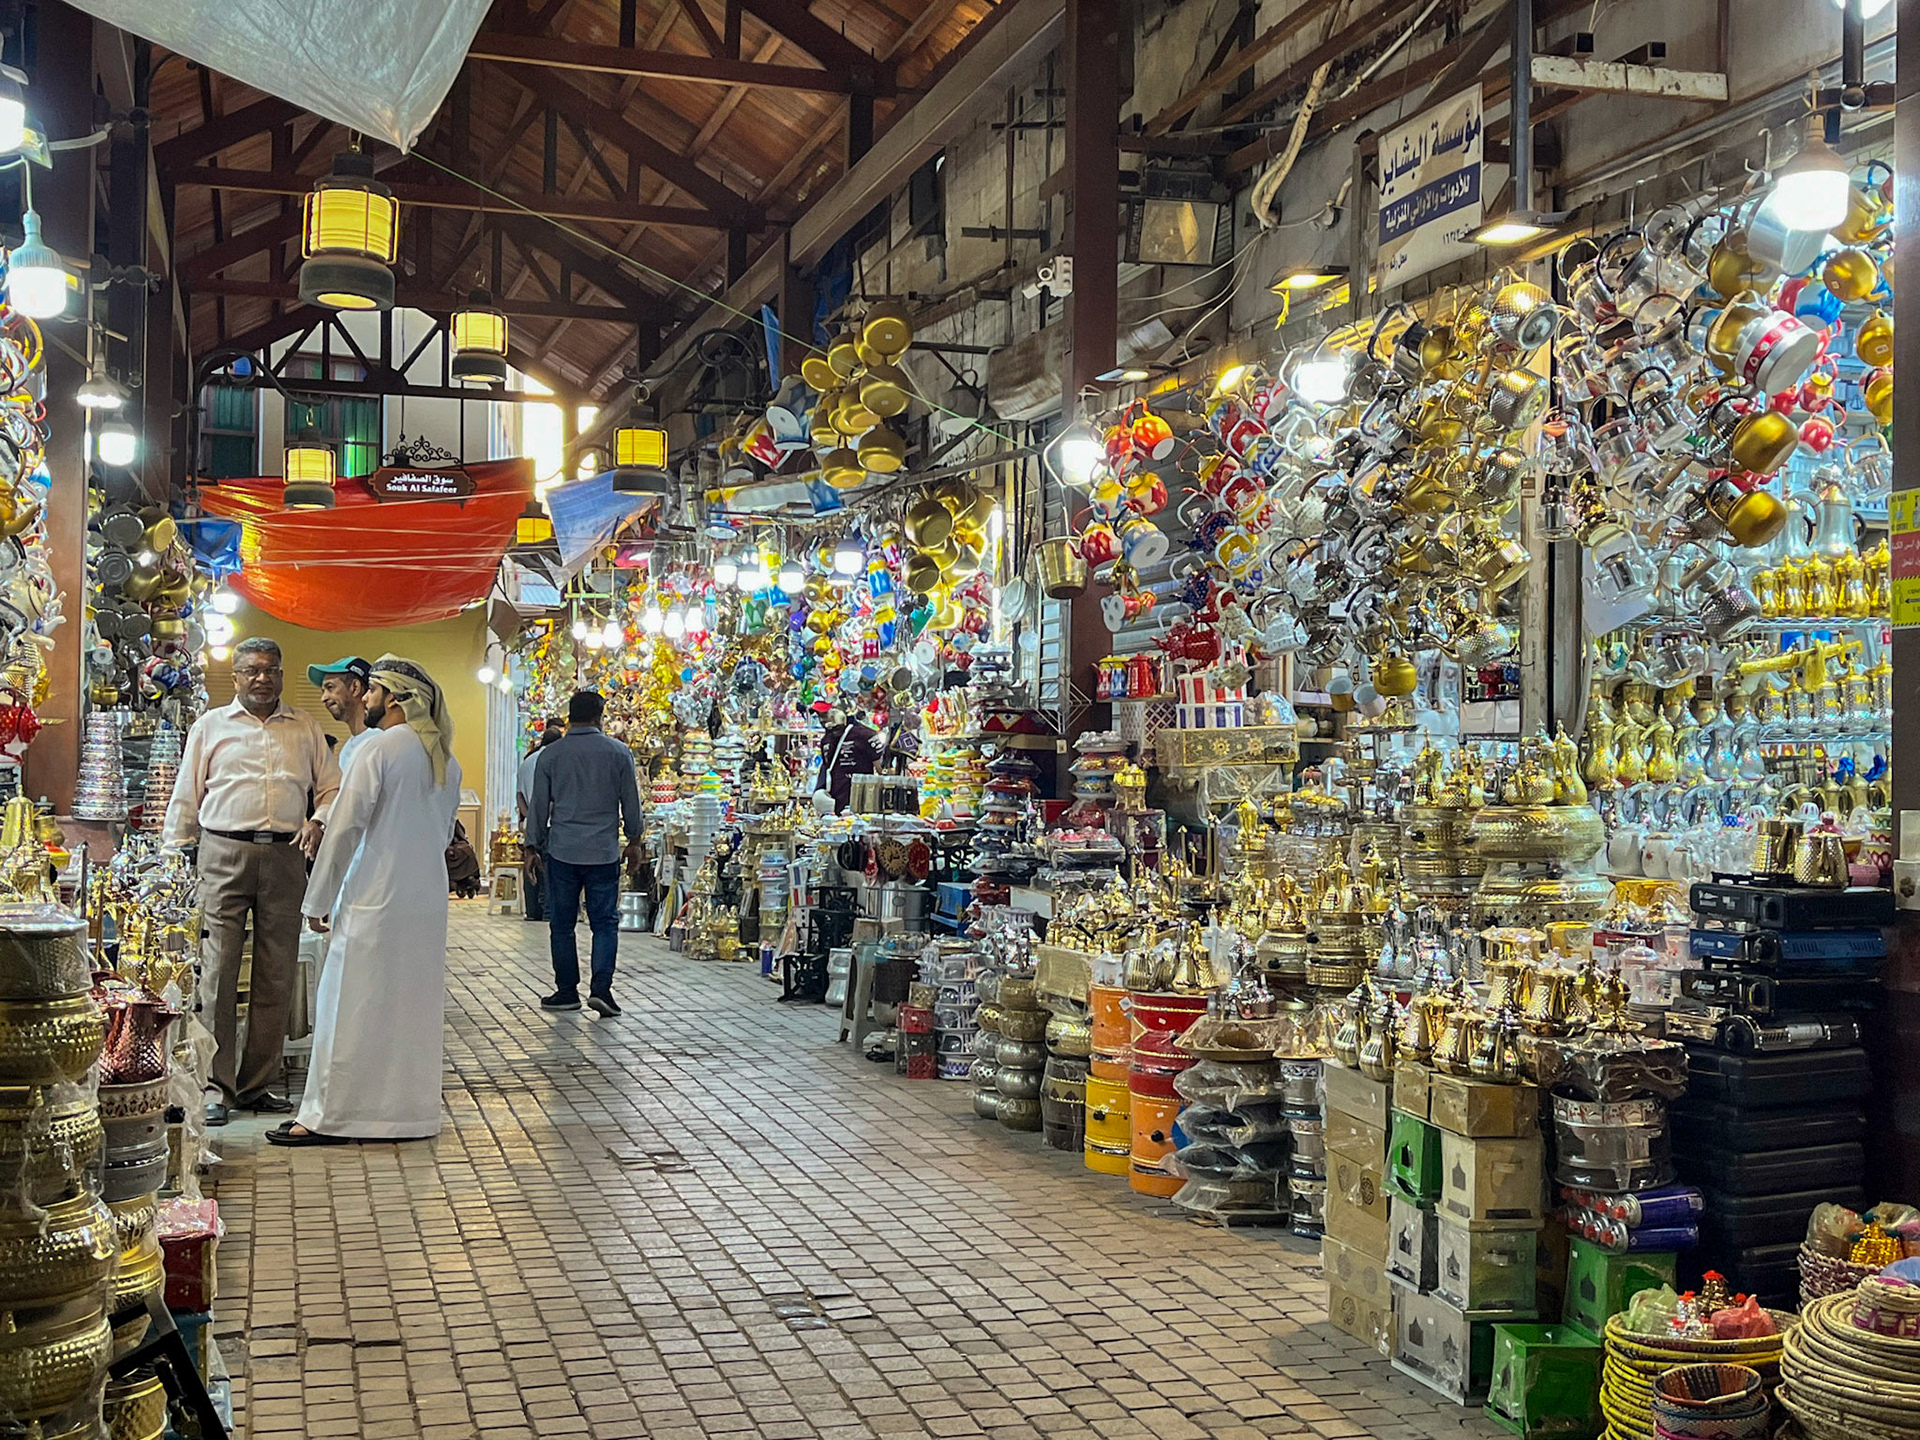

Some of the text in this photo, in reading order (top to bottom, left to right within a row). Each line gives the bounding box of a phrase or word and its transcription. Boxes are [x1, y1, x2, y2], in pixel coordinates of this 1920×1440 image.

[1380, 107, 1482, 195] مؤسسة البشاير
[1440, 173, 1470, 205] للأدوات
[1410, 189, 1438, 225] والأواني
[386, 483, 408, 492] Souk
[410, 484, 420, 492] Al
[390, 473, 453, 485] سوق الصفافير
